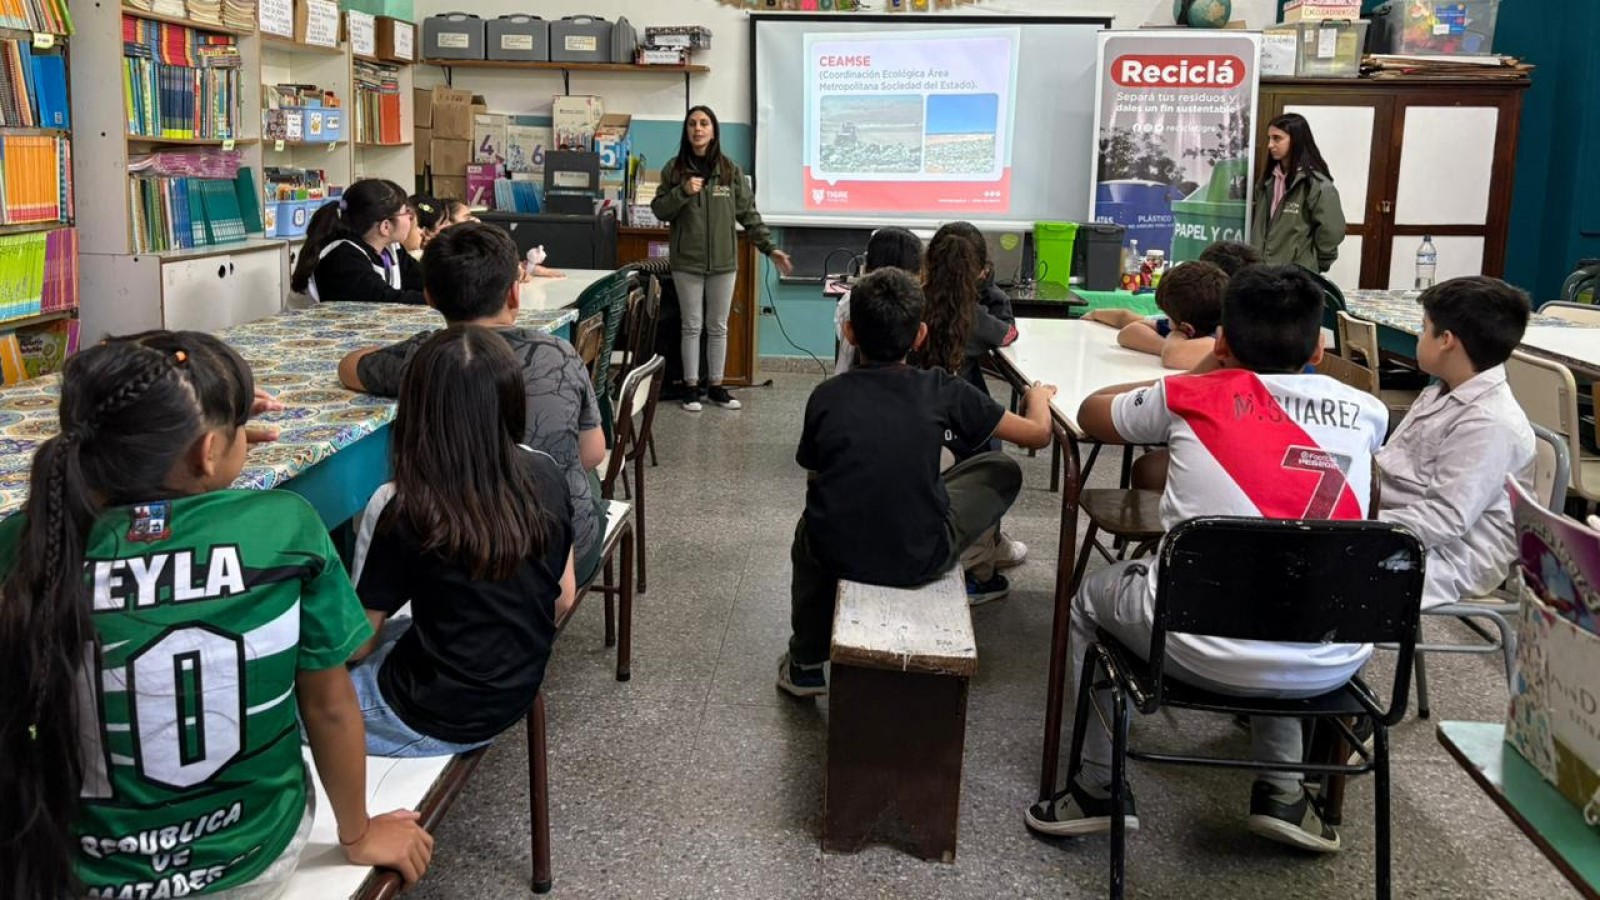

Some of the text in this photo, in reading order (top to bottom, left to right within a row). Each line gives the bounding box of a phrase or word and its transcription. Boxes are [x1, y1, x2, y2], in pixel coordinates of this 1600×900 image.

[819, 56, 871, 67] CEAMSE
[882, 69, 925, 80] Ecológica
[1121, 59, 1235, 84] Reciclá
[819, 82, 879, 92] Metropolitana
[881, 80, 922, 91] Sociedad
[924, 80, 938, 90] del
[1158, 93, 1176, 102] tus
[1178, 92, 1226, 102] residuos
[1116, 103, 1142, 113] dales
[1145, 105, 1158, 113] un
[1160, 104, 1175, 113] fin
[480, 134, 494, 155] 4
[600, 142, 616, 166] 5
[532, 145, 546, 165] 6
[1175, 223, 1208, 241] PAPEL
[1210, 226, 1221, 242] Y
[84, 543, 246, 611] EYLA
